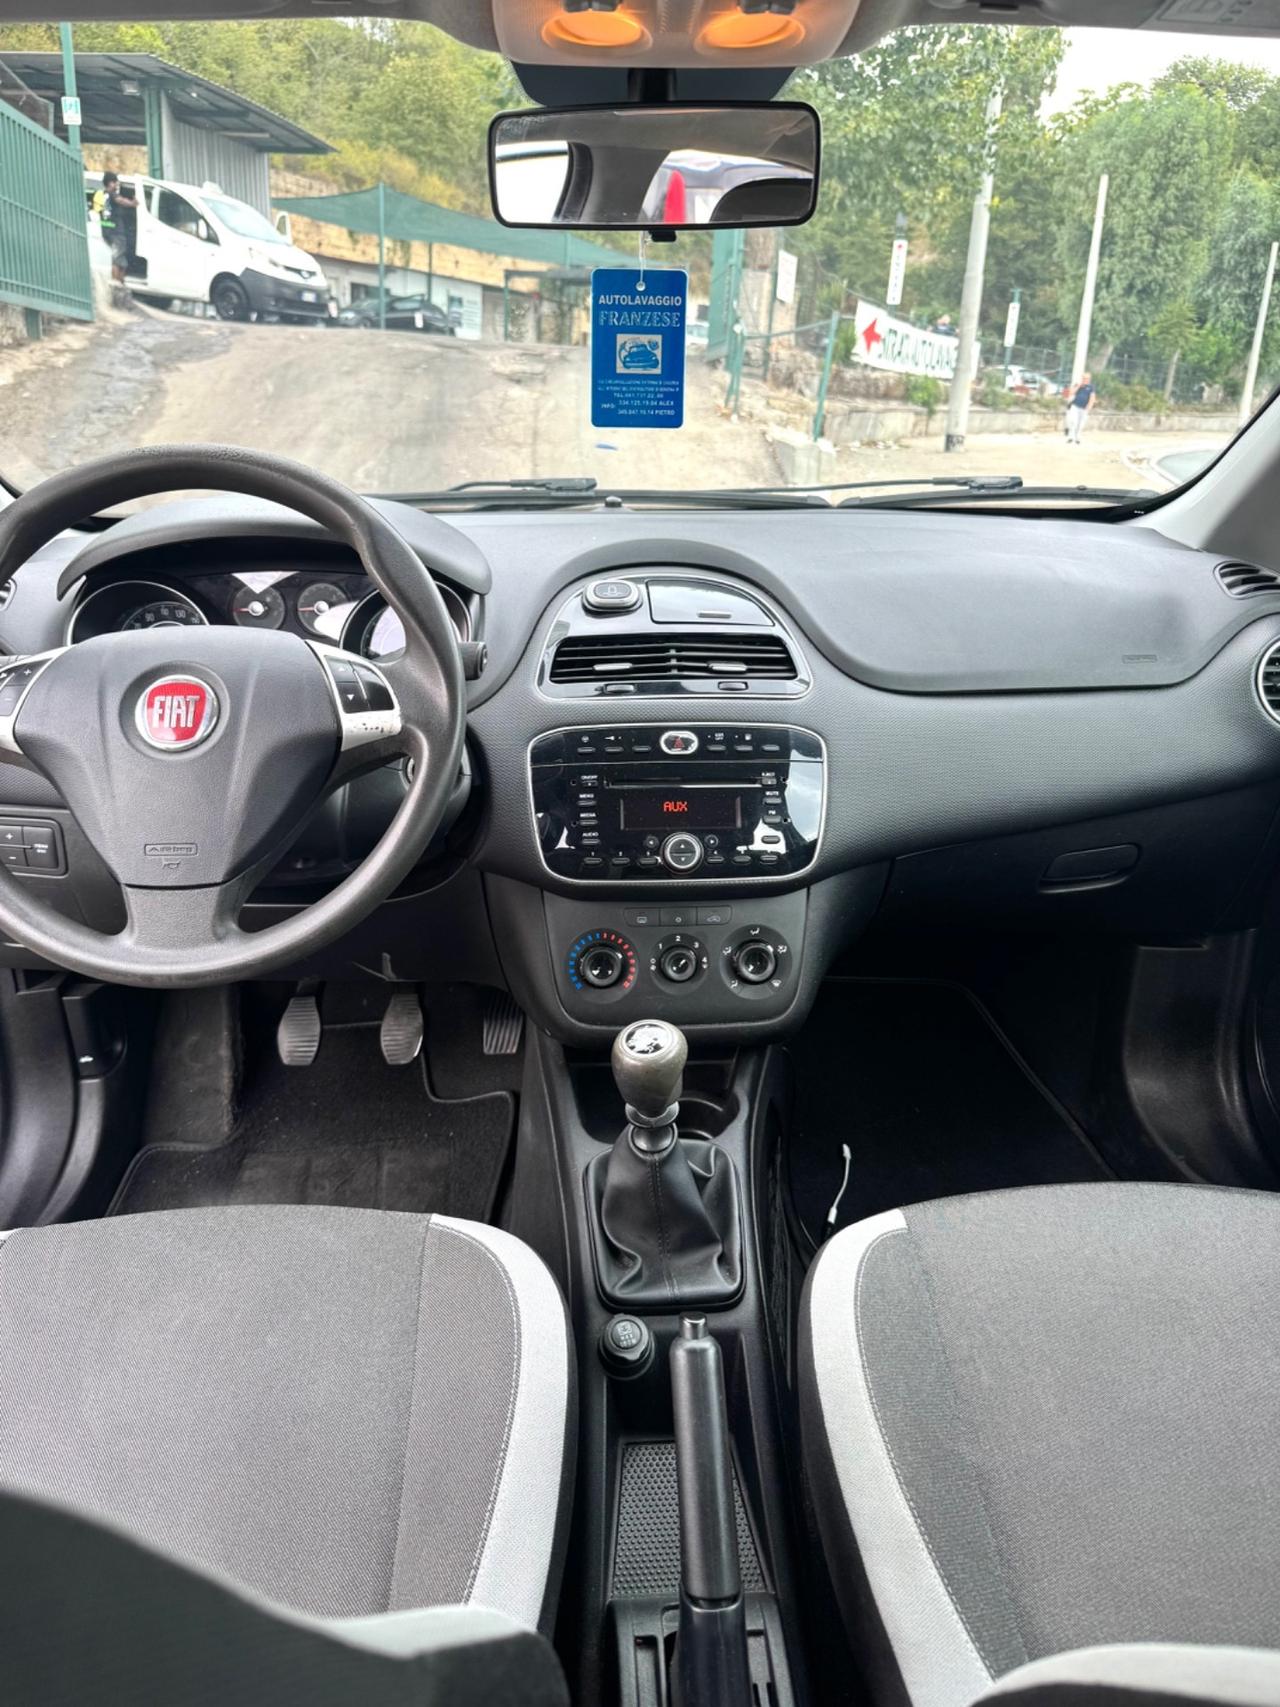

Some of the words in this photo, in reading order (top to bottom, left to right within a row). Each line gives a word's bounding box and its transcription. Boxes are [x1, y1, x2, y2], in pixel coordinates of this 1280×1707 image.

[599, 295, 682, 306] AUTOLAVAGGIO
[599, 311, 681, 327] FRANZESE
[152, 695, 200, 728] FIAT
[663, 801, 688, 812] AUX
